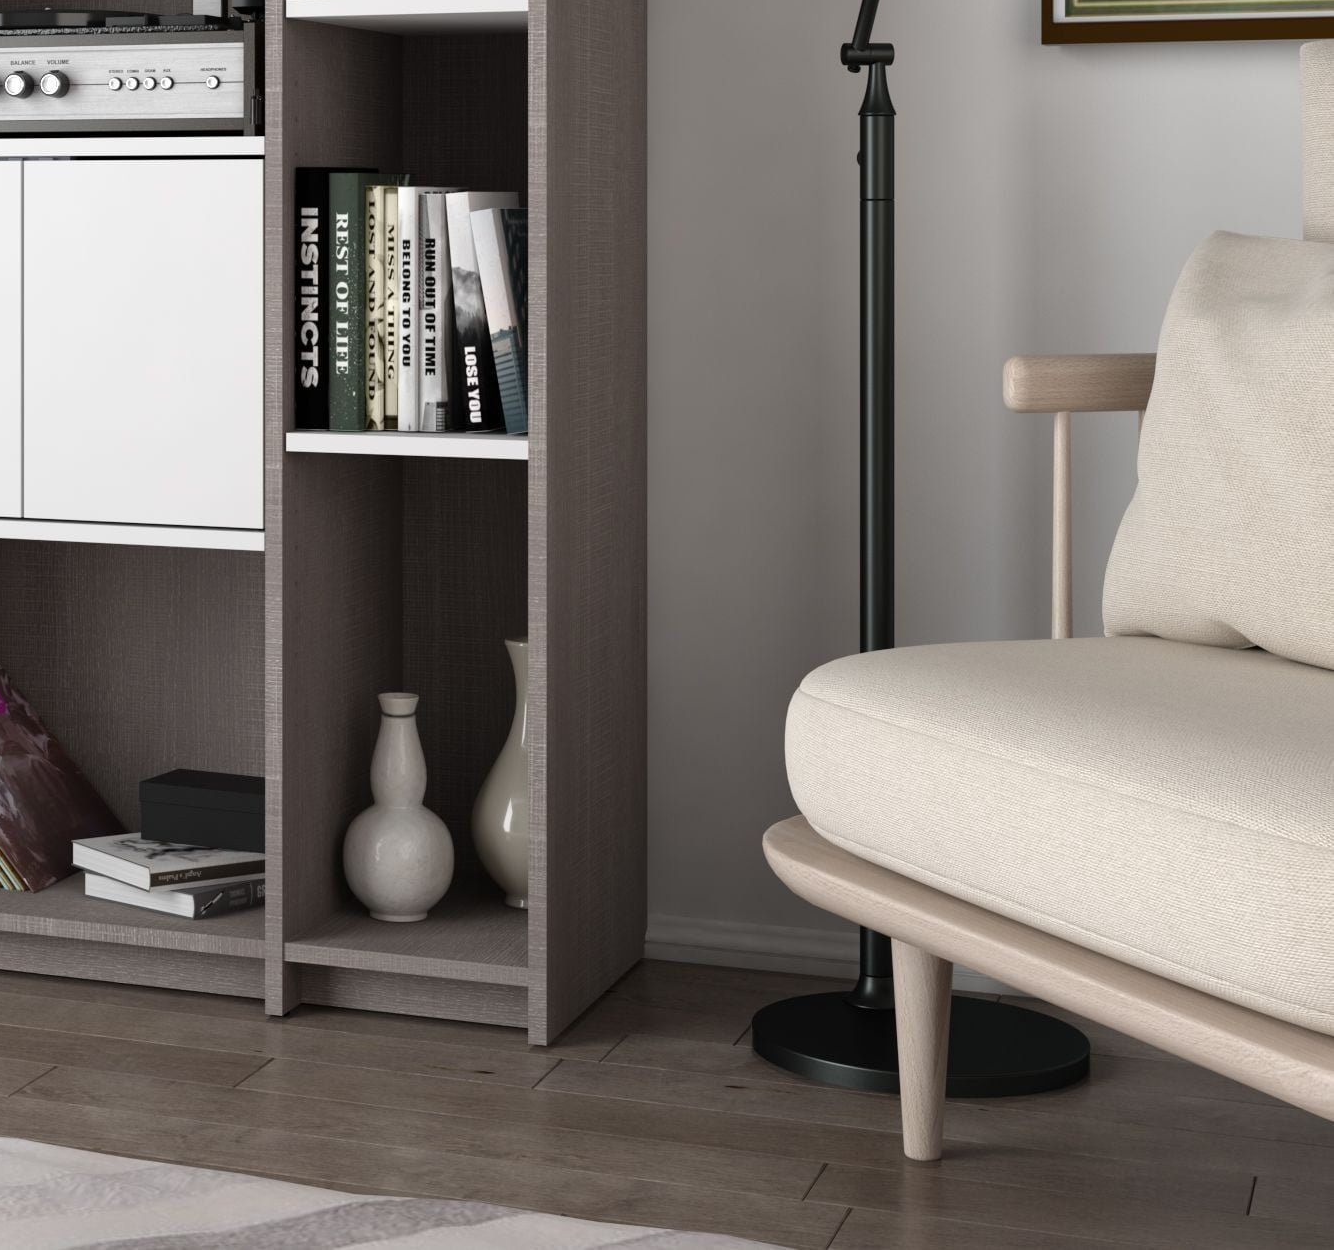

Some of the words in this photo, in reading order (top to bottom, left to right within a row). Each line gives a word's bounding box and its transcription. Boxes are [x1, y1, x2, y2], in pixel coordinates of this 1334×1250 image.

[335, 212, 349, 275] REST
[368, 201, 376, 260] LOST
[387, 224, 395, 281] MISS
[402, 239, 411, 303] BELONG
[424, 238, 436, 272] RUN
[300, 207, 319, 389] INSTINCTS
[335, 281, 349, 315] OF
[368, 265, 376, 313] AND
[387, 287, 395, 300] A
[424, 276, 436, 309] OUT
[402, 307, 411, 328] TO
[424, 313, 436, 333] OF
[335, 321, 349, 375] LIFE
[368, 321, 376, 401] FOUND
[387, 310, 395, 380] THING
[402, 333, 411, 367] YOU
[424, 336, 436, 376] TIME
[463, 345, 479, 387] LOSE
[468, 388, 482, 424] YOU
